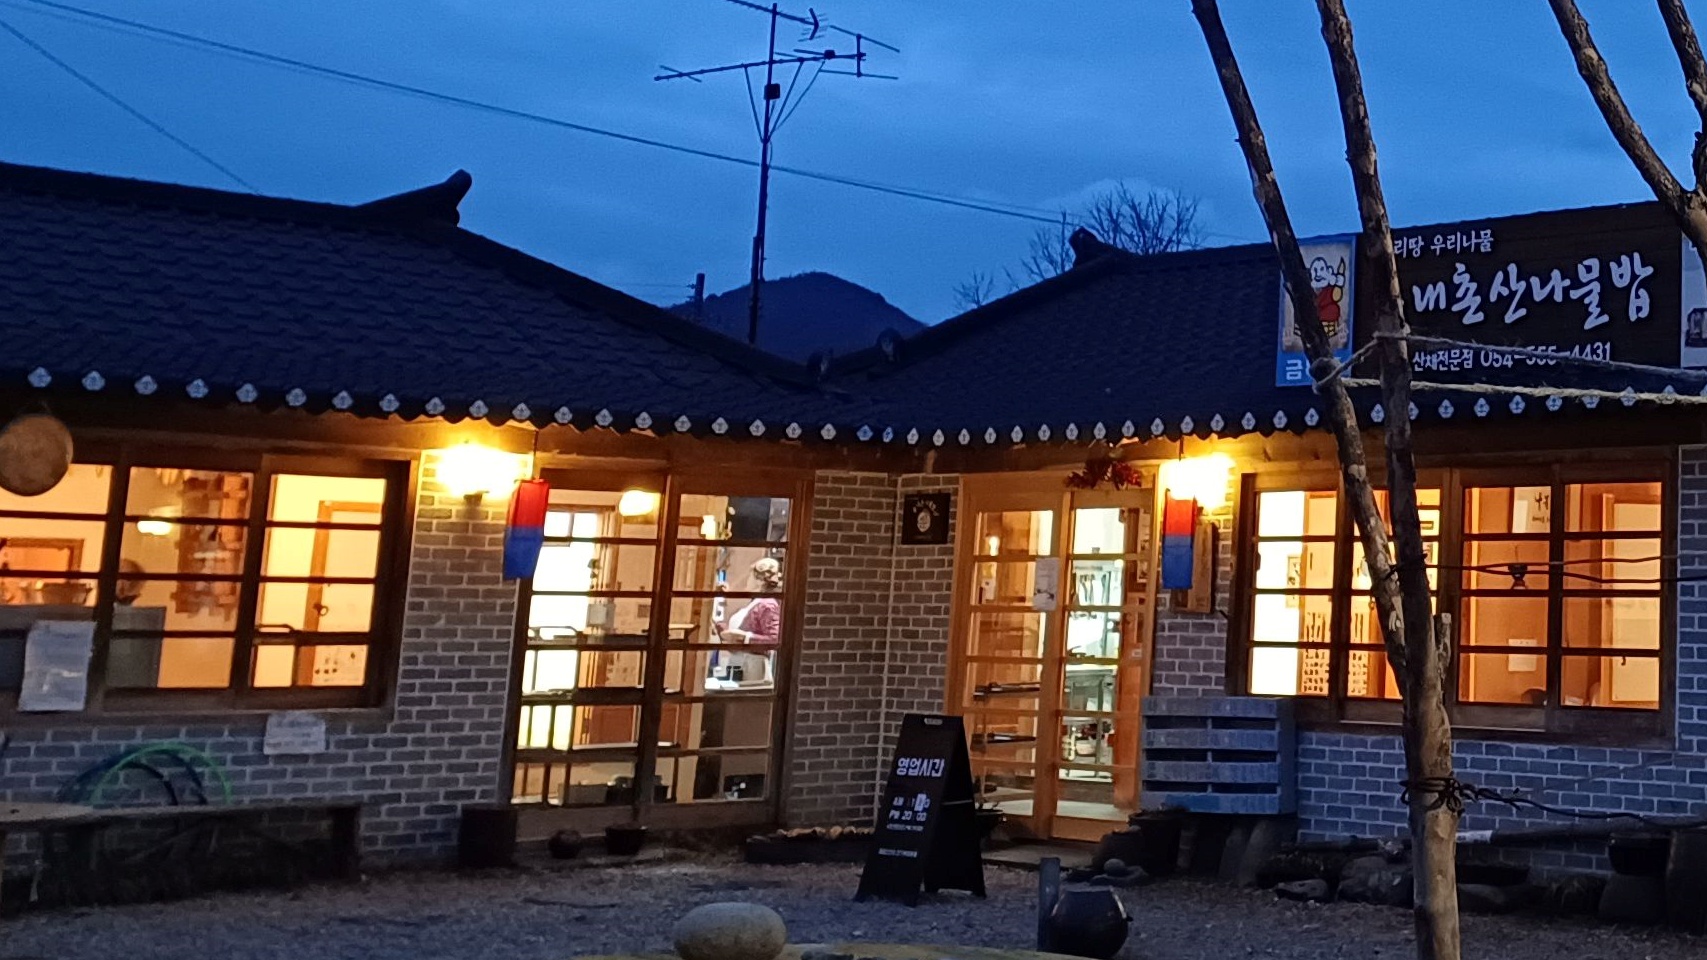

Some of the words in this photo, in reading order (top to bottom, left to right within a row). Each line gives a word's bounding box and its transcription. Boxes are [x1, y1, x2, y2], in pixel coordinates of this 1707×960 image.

[1392, 236, 1425, 259] 리땅
[1430, 228, 1494, 256] 우리나물
[1412, 348, 1474, 372] 산채전문점
[896, 757, 945, 777] 영업시간
